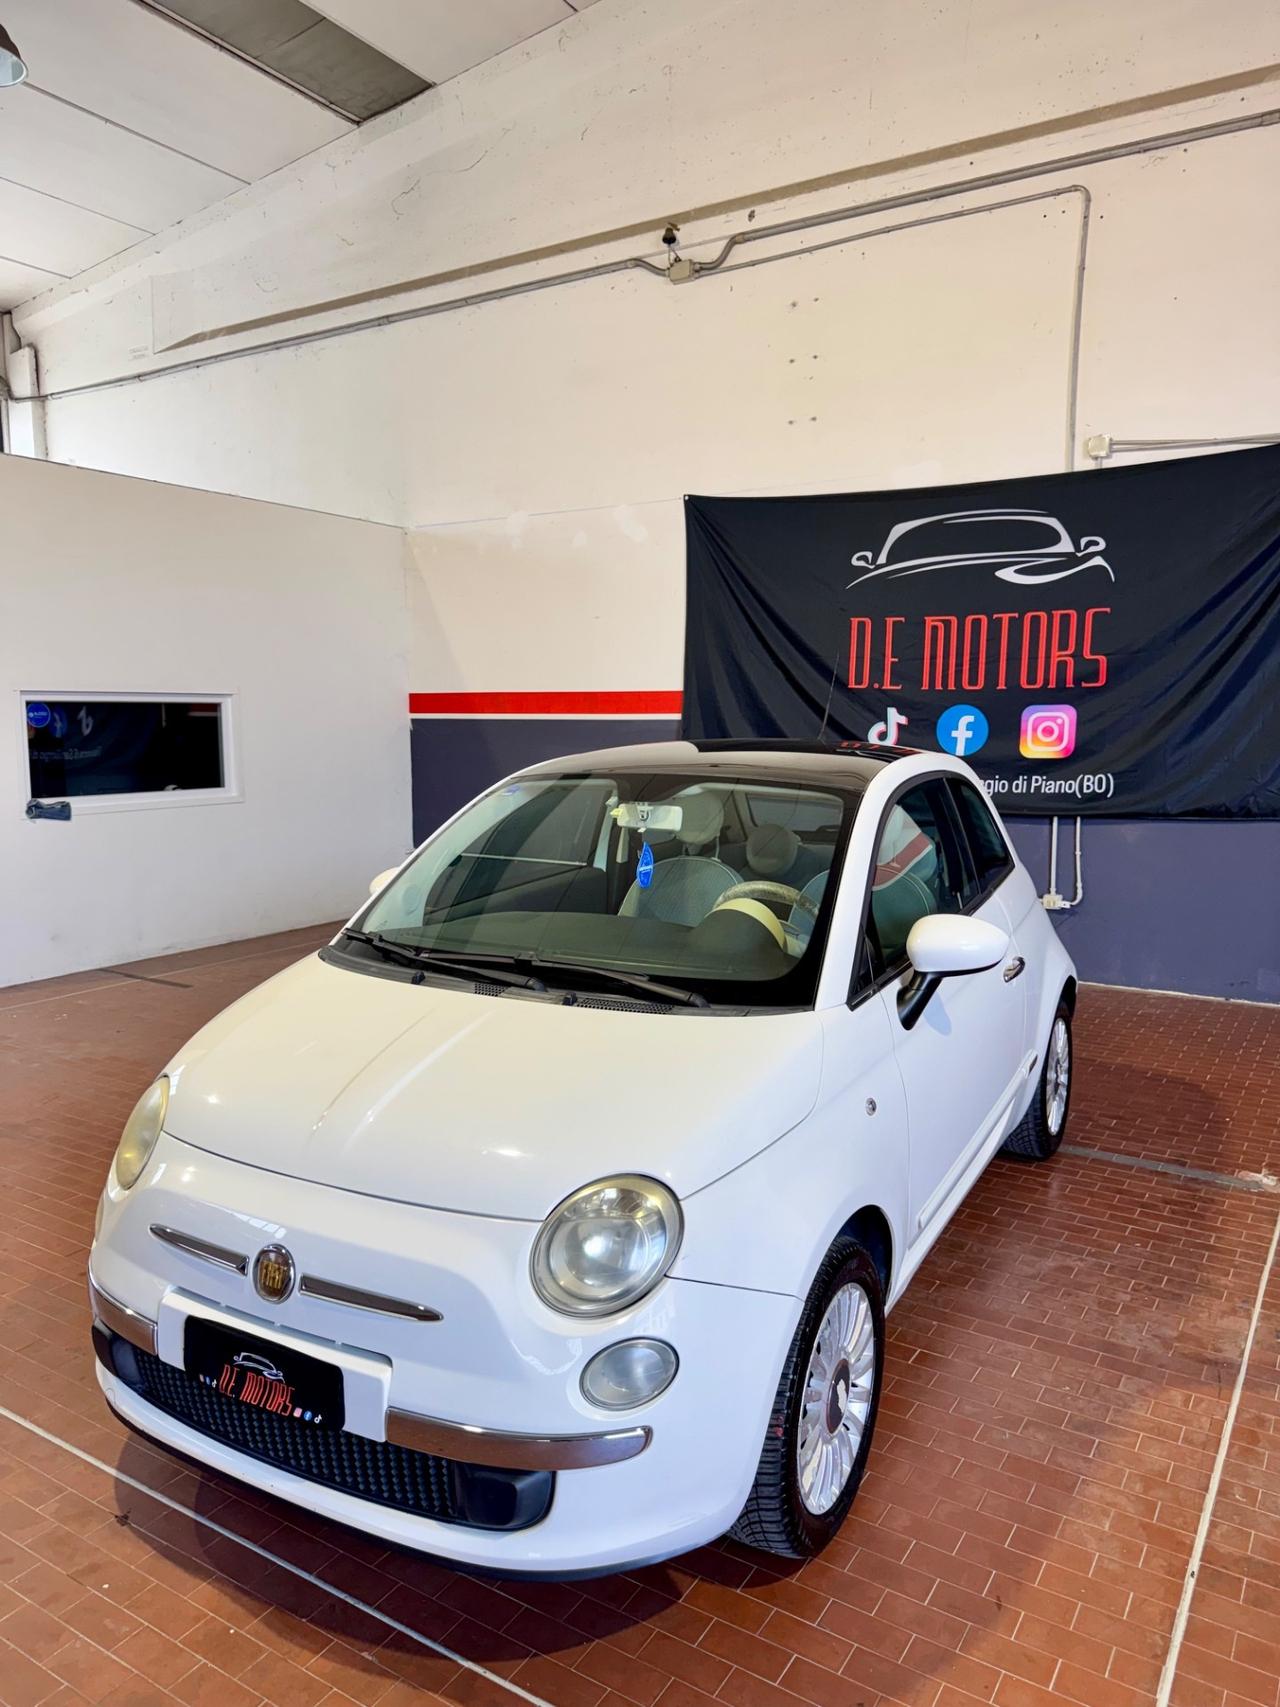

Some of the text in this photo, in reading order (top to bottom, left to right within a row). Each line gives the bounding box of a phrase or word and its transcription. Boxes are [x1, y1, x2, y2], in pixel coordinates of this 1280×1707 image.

[848, 607, 1111, 690] D.E MOTORS
[981, 775, 1009, 797] gio
[1012, 775, 1027, 793] di
[239, 1371, 296, 1417] MOTORS
